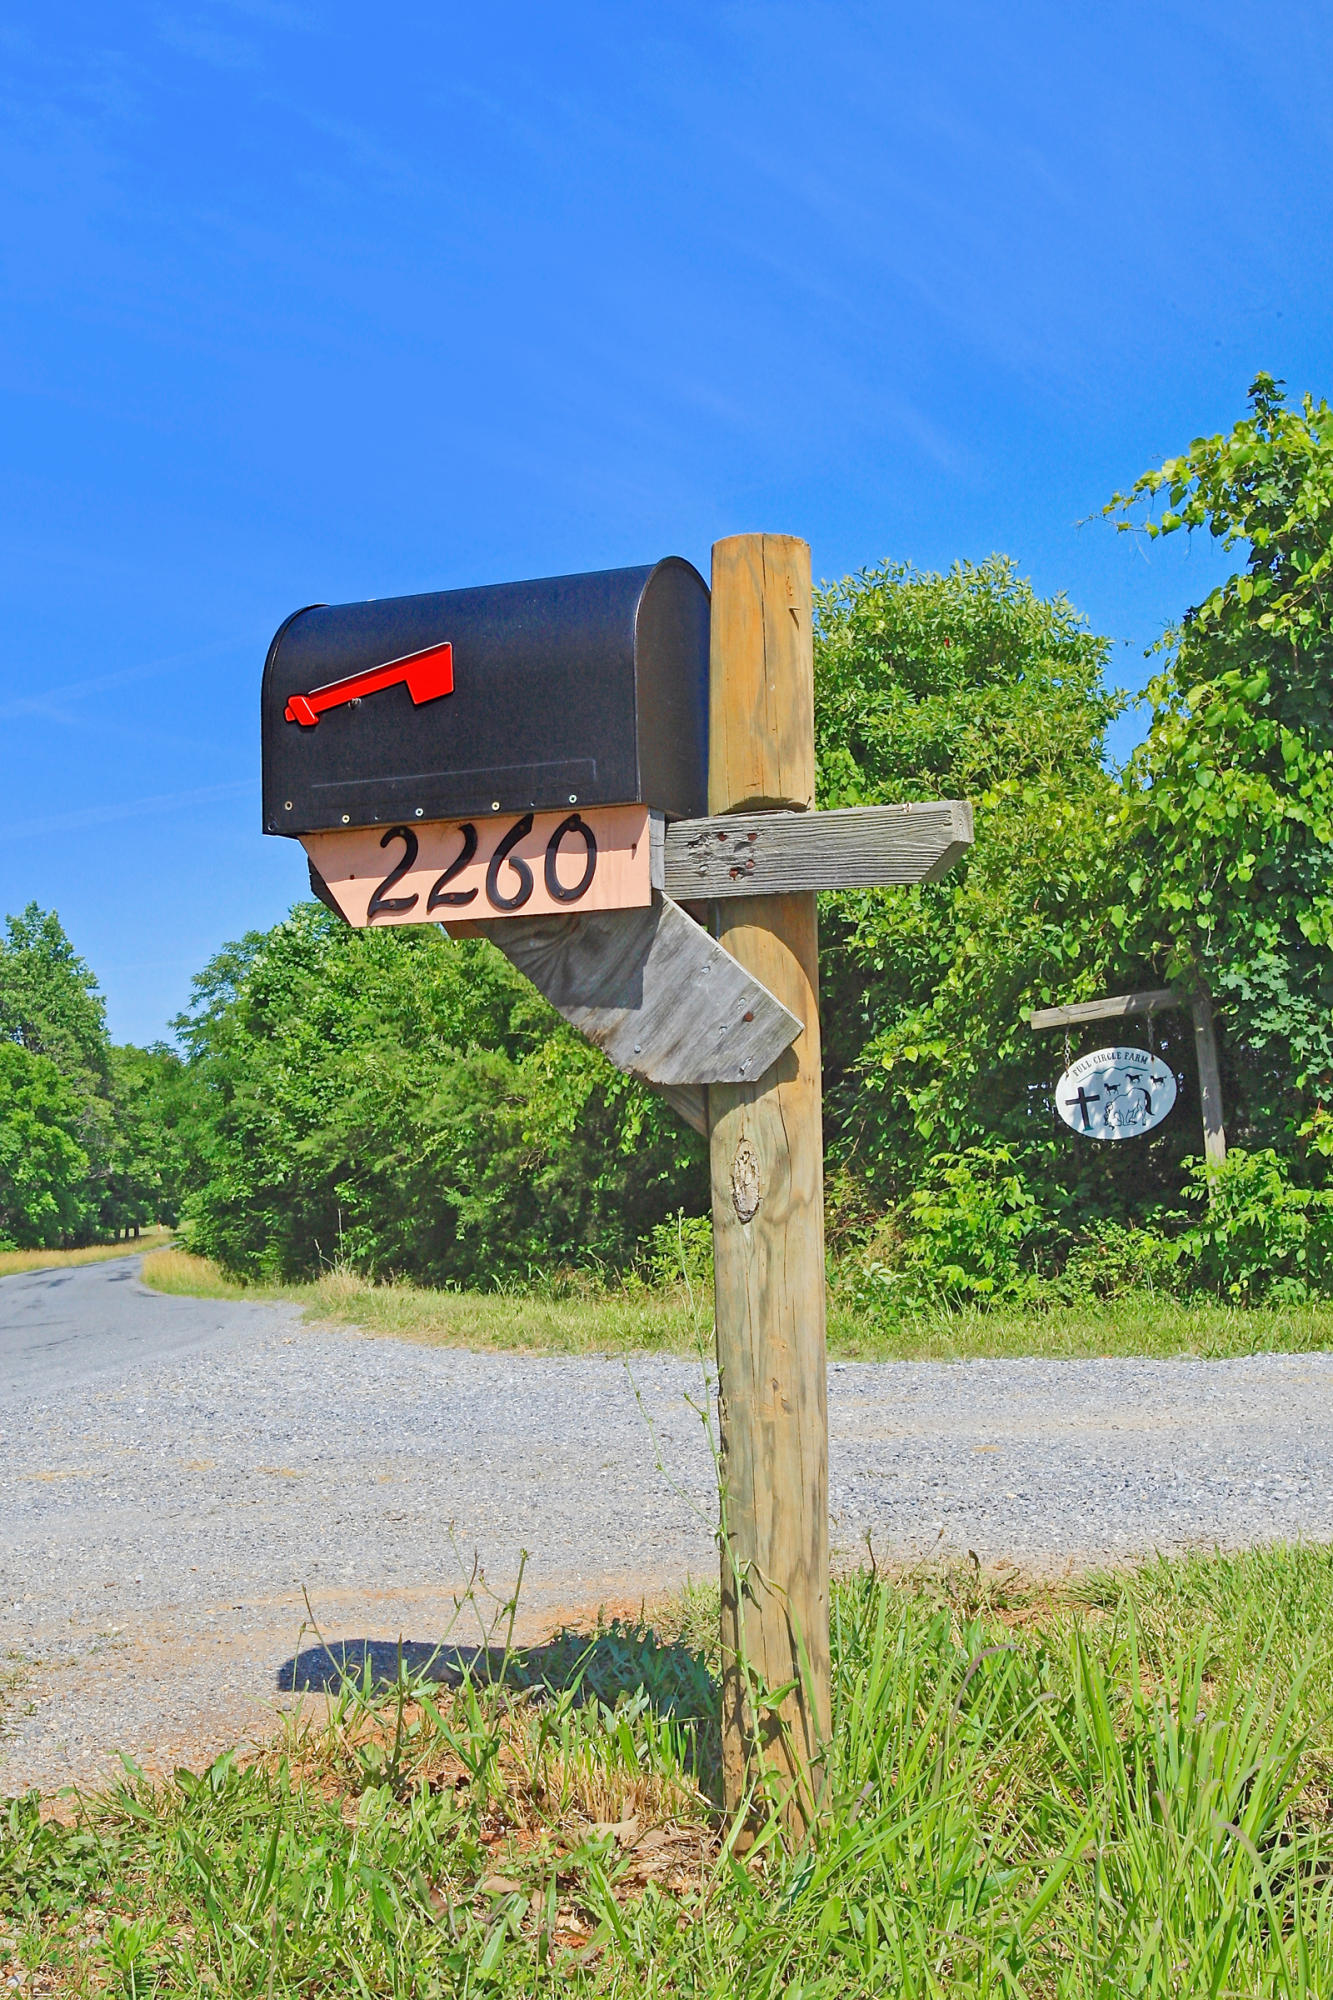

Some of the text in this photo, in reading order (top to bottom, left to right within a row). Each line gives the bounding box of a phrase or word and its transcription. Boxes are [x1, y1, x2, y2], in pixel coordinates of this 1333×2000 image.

[367, 813, 597, 917] 2260
[1072, 1052, 1148, 1077] FULL CIRCLE FARM
